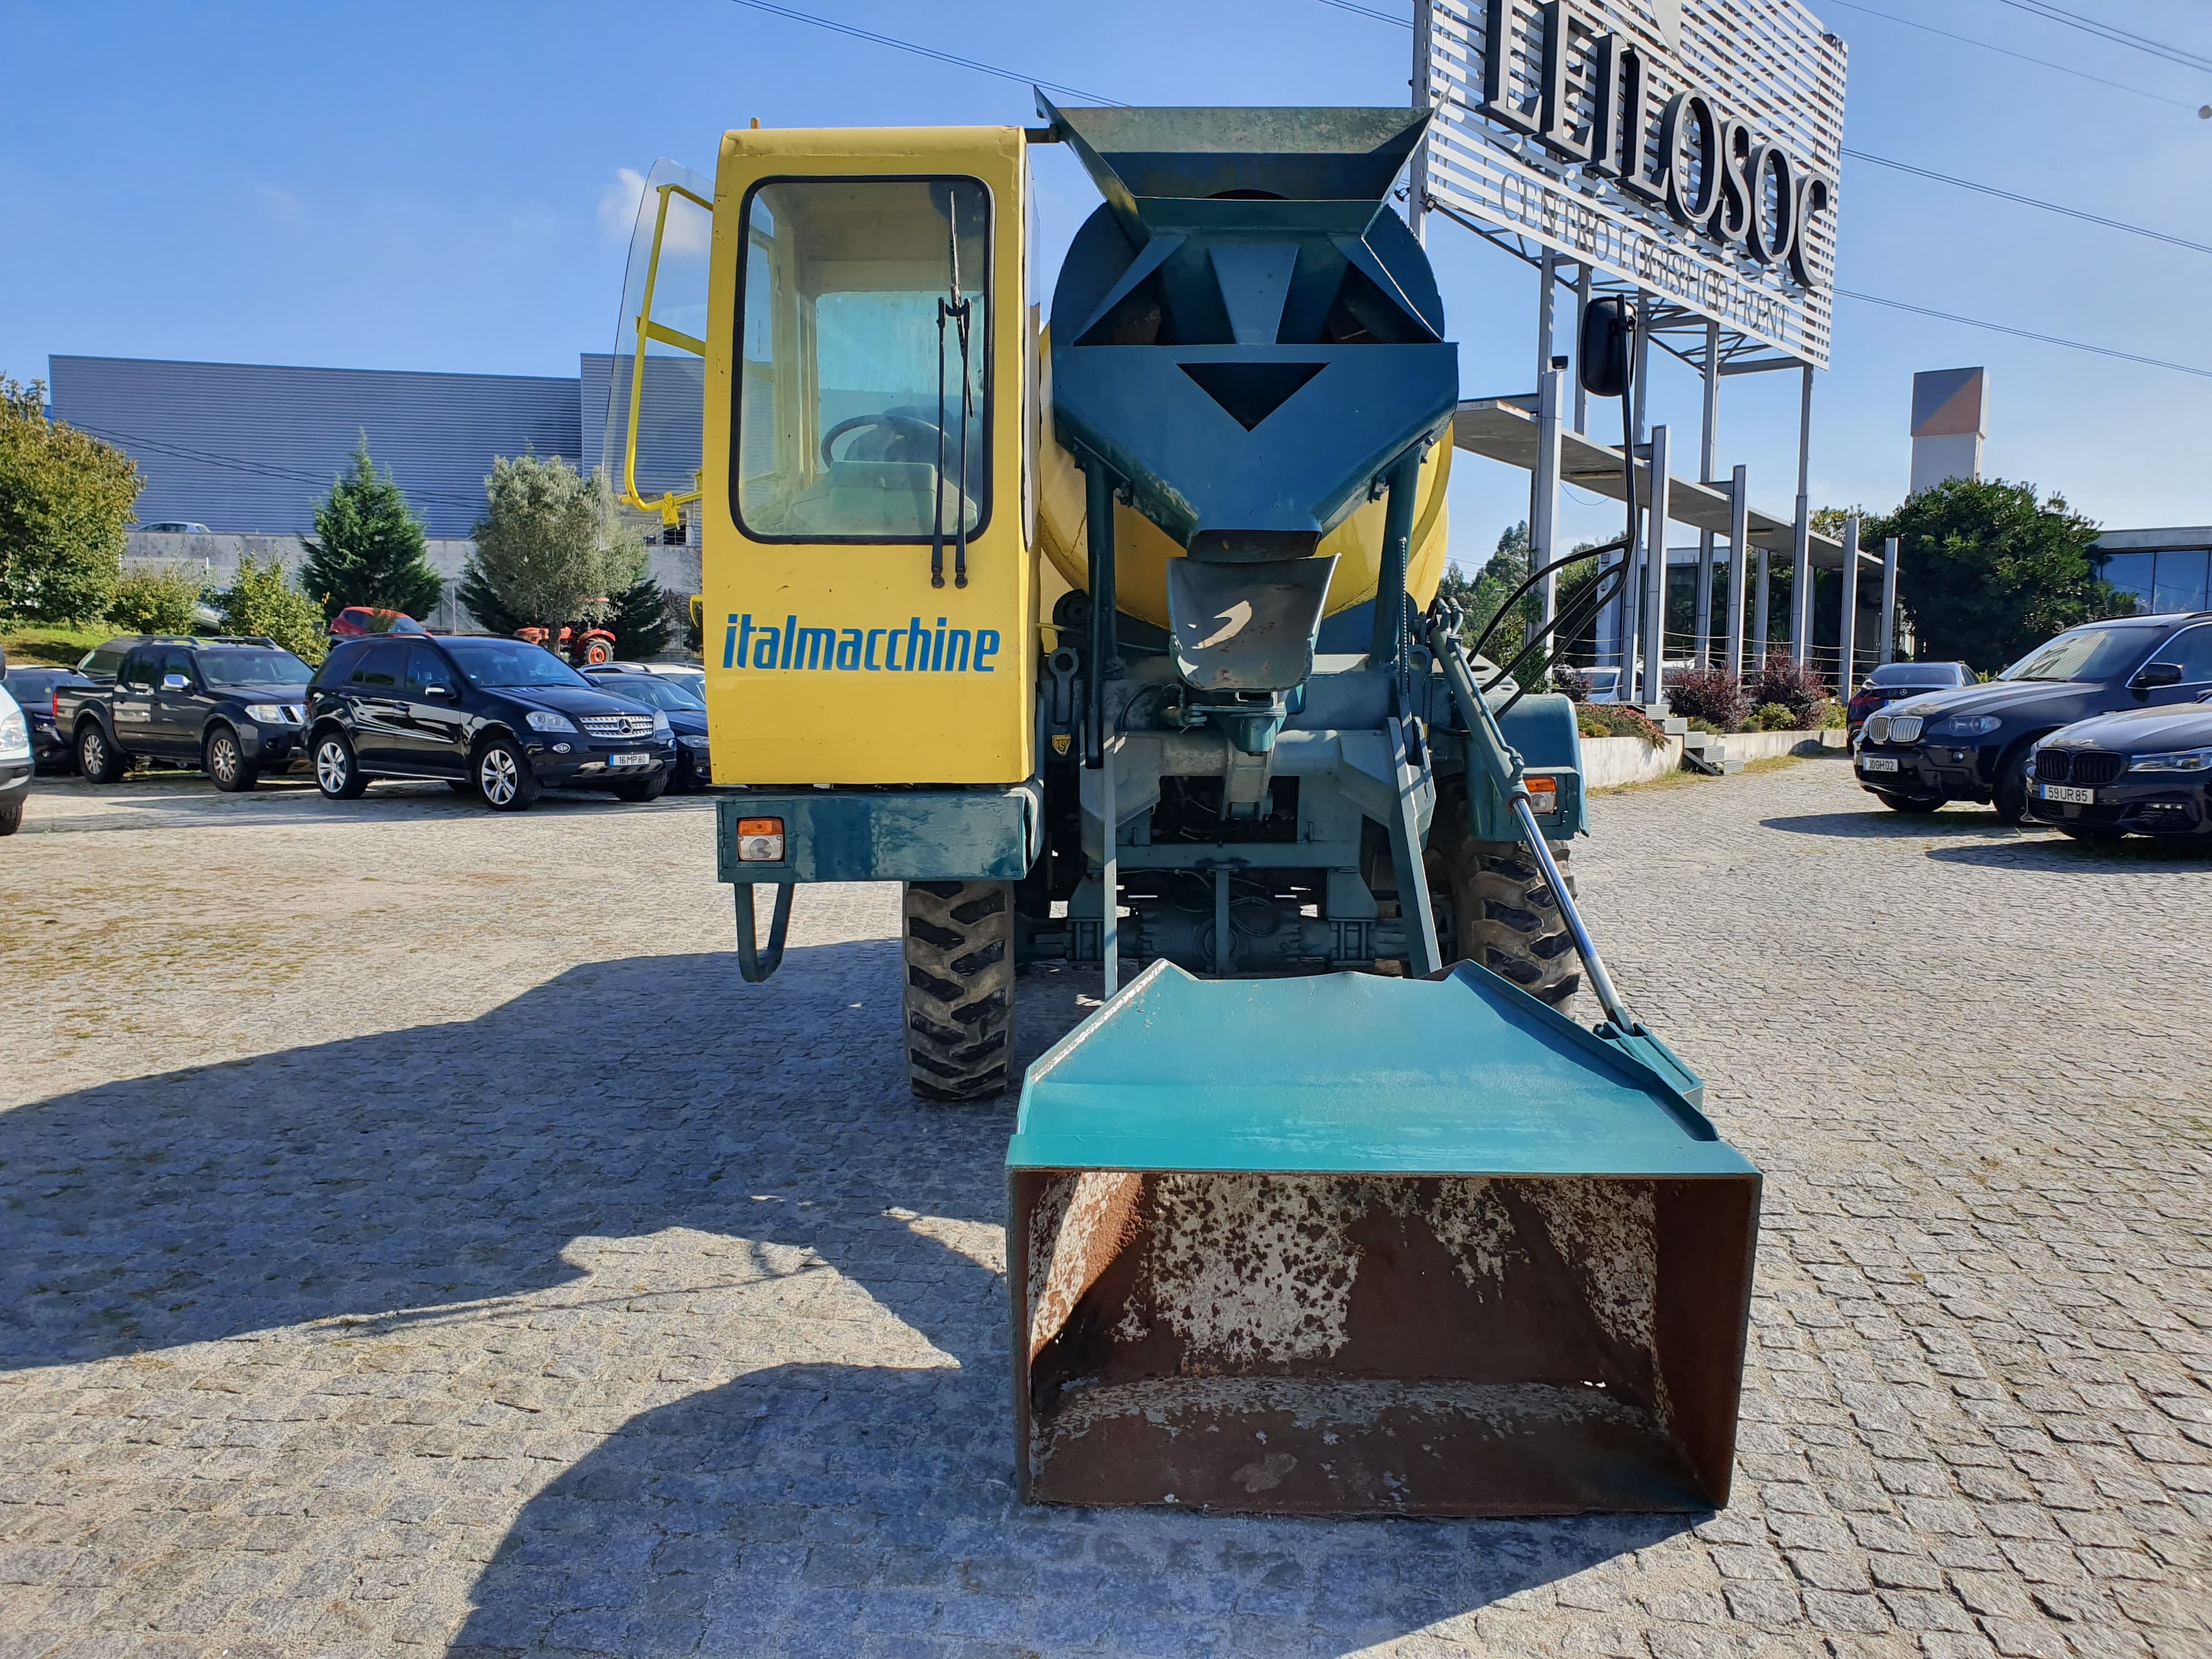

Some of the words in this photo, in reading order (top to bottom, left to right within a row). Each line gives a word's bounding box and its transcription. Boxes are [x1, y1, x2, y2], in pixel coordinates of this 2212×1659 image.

[1476, 0, 1831, 287] LEILOSOC
[1501, 173, 1609, 261] CENTRO
[1743, 289, 1789, 341] RENT
[723, 613, 1000, 672] italmacchine
